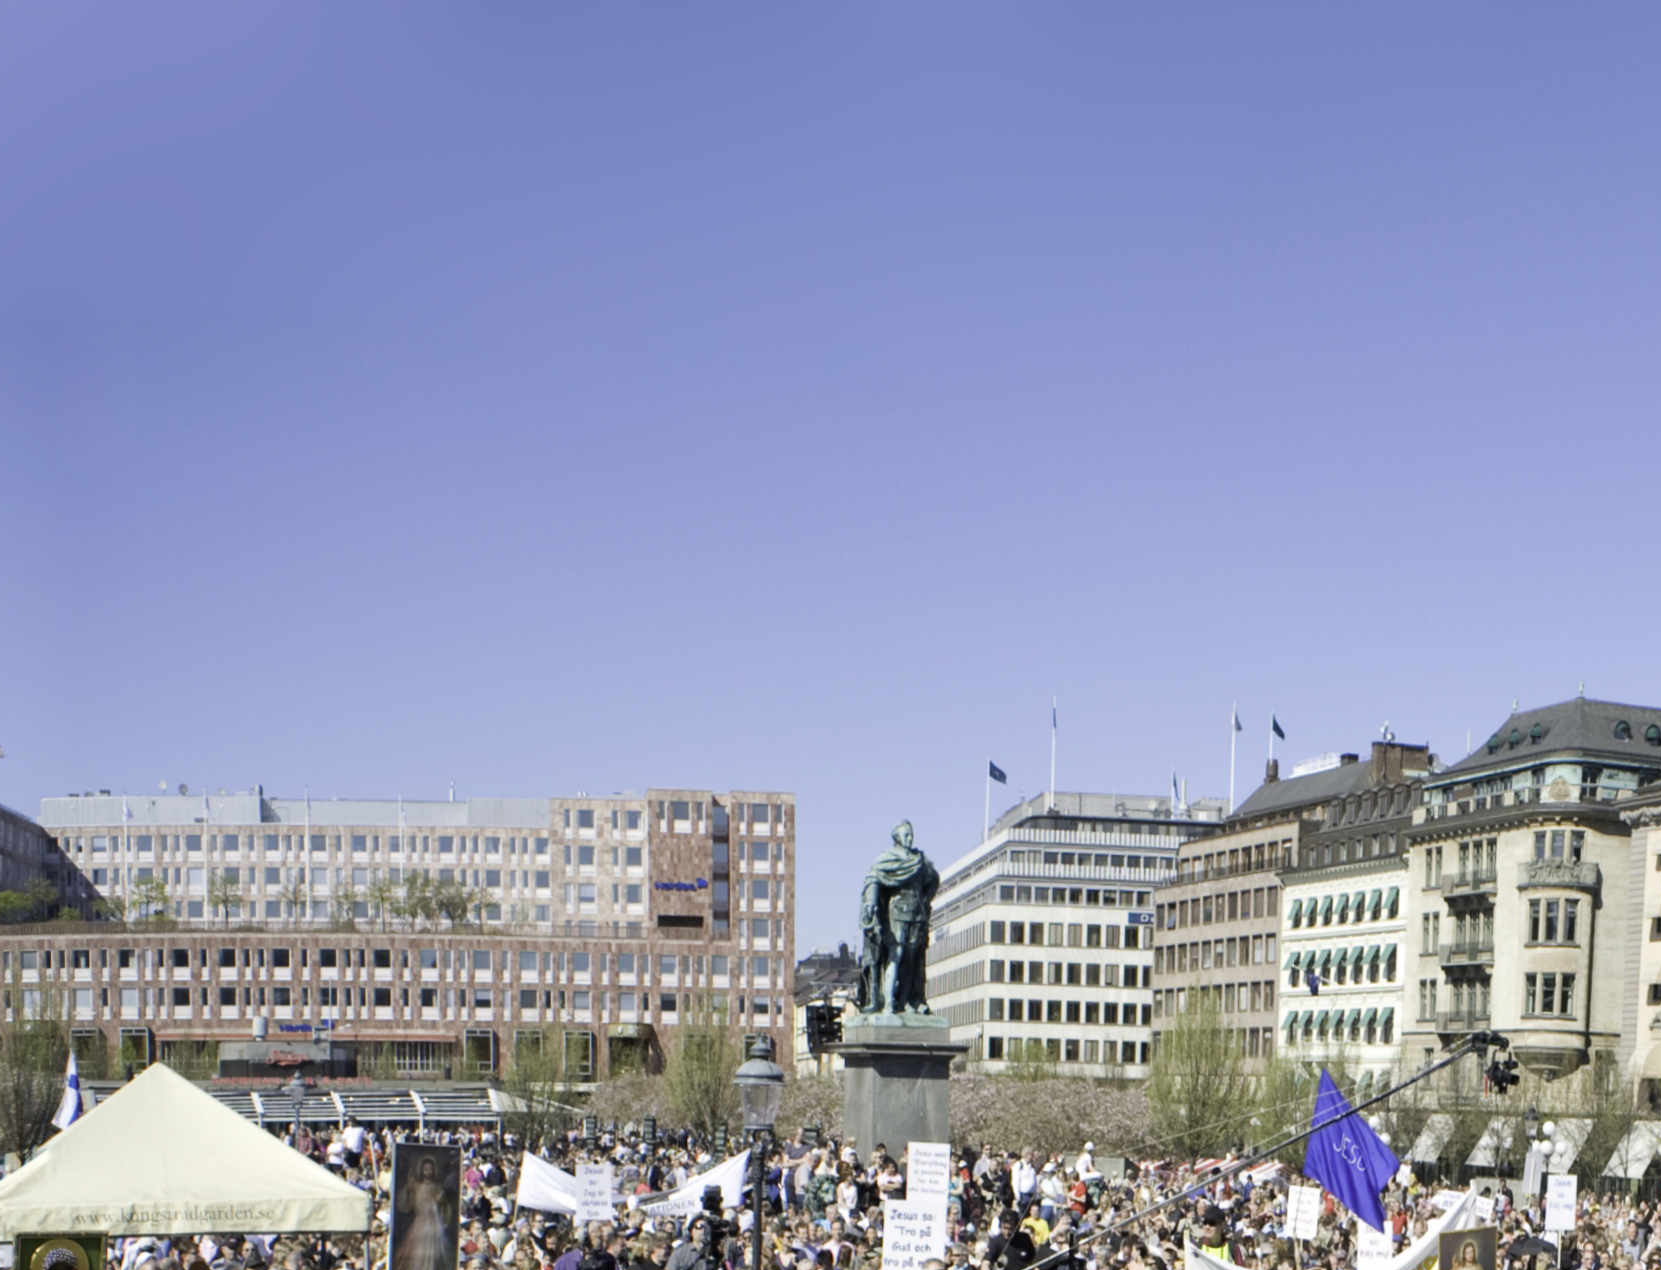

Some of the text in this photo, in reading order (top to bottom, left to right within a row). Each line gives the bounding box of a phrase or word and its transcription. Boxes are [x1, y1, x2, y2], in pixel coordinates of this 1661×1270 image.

[890, 1208, 918, 1221] Jesus
[891, 1241, 931, 1253] Gud och
[883, 1257, 899, 1267] tro
